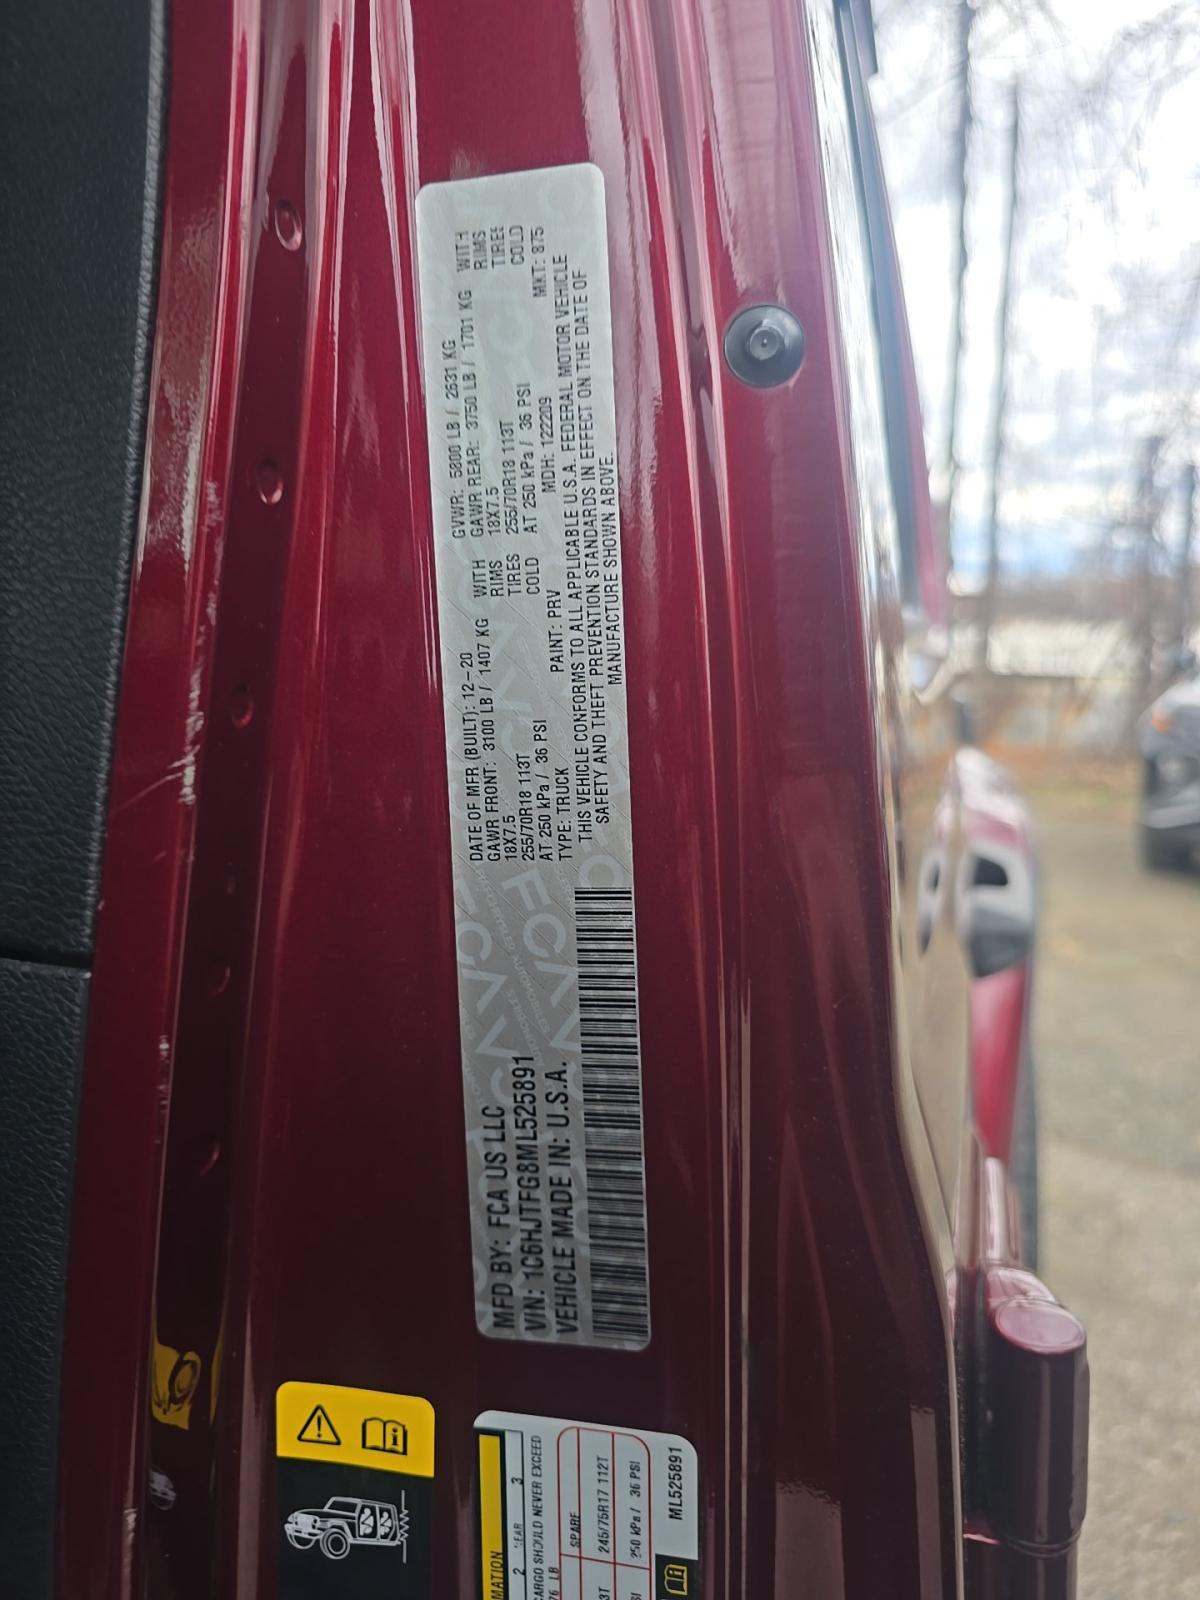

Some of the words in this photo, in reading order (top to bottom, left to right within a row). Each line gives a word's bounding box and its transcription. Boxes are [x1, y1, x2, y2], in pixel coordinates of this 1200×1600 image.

[455, 231, 470, 272] WITH
[472, 230, 487, 270] RIMS
[510, 225, 524, 265] COLD
[531, 226, 545, 254] 875
[531, 260, 547, 297] MKT:
[553, 254, 569, 319] VEHICLE
[572, 269, 587, 289] OF
[458, 290, 472, 310] KG
[574, 295, 589, 335] DATE
[442, 340, 457, 360] KG
[460, 317, 474, 350] 1701
[556, 323, 572, 377] MOTOR
[575, 341, 590, 372] THE
[445, 367, 458, 400] 2631
[463, 373, 476, 390] LB
[517, 383, 531, 407] PSI
[578, 377, 591, 398] ON
[447, 422, 461, 438] LB
[465, 396, 478, 430] 3750
[519, 413, 532, 430] 36
[539, 397, 553, 447] 122209
[560, 382, 575, 451] FEDERAL
[500, 421, 514, 454] 113T
[578, 405, 594, 459] EFFECT
[448, 445, 462, 478] 5800
[467, 441, 481, 487] REAR:
[520, 452, 535, 478] kPa
[541, 453, 556, 493] MDH:
[581, 466, 595, 480] IN
[599, 452, 615, 506] ABOVE.
[502, 460, 519, 534] 255/70R18
[523, 484, 536, 508] 250
[562, 458, 578, 504] U.S.A.
[450, 490, 465, 538] GVWR:
[469, 493, 484, 537] GAWR
[486, 487, 501, 536] 18X7.5
[523, 516, 537, 534] AT
[582, 487, 599, 578] STANDARDS
[602, 512, 617, 568] SHOWN
[564, 510, 582, 600] APPLICABLE
[472, 560, 487, 597] WITH
[489, 560, 504, 597] RIMS
[506, 554, 521, 596] TIRES
[525, 557, 540, 595] COLD
[547, 590, 561, 618] PRV
[568, 606, 583, 632] ALL
[476, 618, 489, 637] KG
[586, 584, 604, 675] PREVENTION
[603, 573, 622, 684] MANUFACTURE
[478, 643, 491, 675] 1407
[548, 625, 564, 672] PAINT:
[570, 638, 584, 656] TO
[480, 698, 493, 713] LB
[571, 663, 588, 742] CONFORMS
[590, 683, 605, 728] THEFT
[462, 706, 481, 760] (BUILT):
[481, 720, 496, 751] 3100
[533, 719, 548, 741] PSI
[535, 748, 548, 763] 36
[593, 735, 607, 764] AND
[466, 767, 480, 796] MFR
[484, 762, 499, 812] FRONT:
[517, 754, 531, 784] 113T
[575, 748, 590, 804] VEHICLE
[537, 784, 550, 808] kPa
[555, 768, 570, 814] TRUCK
[594, 770, 609, 823] SAFETY
[467, 802, 481, 820] OF
[519, 791, 534, 861] 255/70R18
[538, 814, 552, 837] 250
[578, 811, 592, 842] THIS
[470, 826, 483, 861] DATE
[487, 819, 500, 861] GAWR
[503, 815, 517, 861] 18X7.5
[539, 844, 553, 861] AT
[558, 821, 572, 861] TYPE:
[545, 1062, 570, 1127] U.S.A.
[482, 1106, 506, 1142] LLC
[484, 1151, 507, 1179] US
[512, 1056, 544, 1280] 1C6HJTFG8ML525891
[548, 1138, 571, 1167] IN:
[486, 1190, 510, 1228] FCA
[549, 1176, 574, 1238] MADE
[490, 1240, 512, 1273] BY:
[492, 1282, 515, 1329] MFD
[552, 1247, 578, 1334] VEHICLE
[523, 1290, 546, 1331] VIN:
[531, 1436, 541, 1477] EXCEED
[596, 1455, 608, 1483] 112T
[629, 1461, 640, 1480] PSI
[532, 1481, 542, 1517] NEVER
[668, 1447, 683, 1520] ML525891
[513, 1522, 523, 1549] EAR
[598, 1490, 609, 1553] 245/75R17
[630, 1516, 641, 1535] kPa
